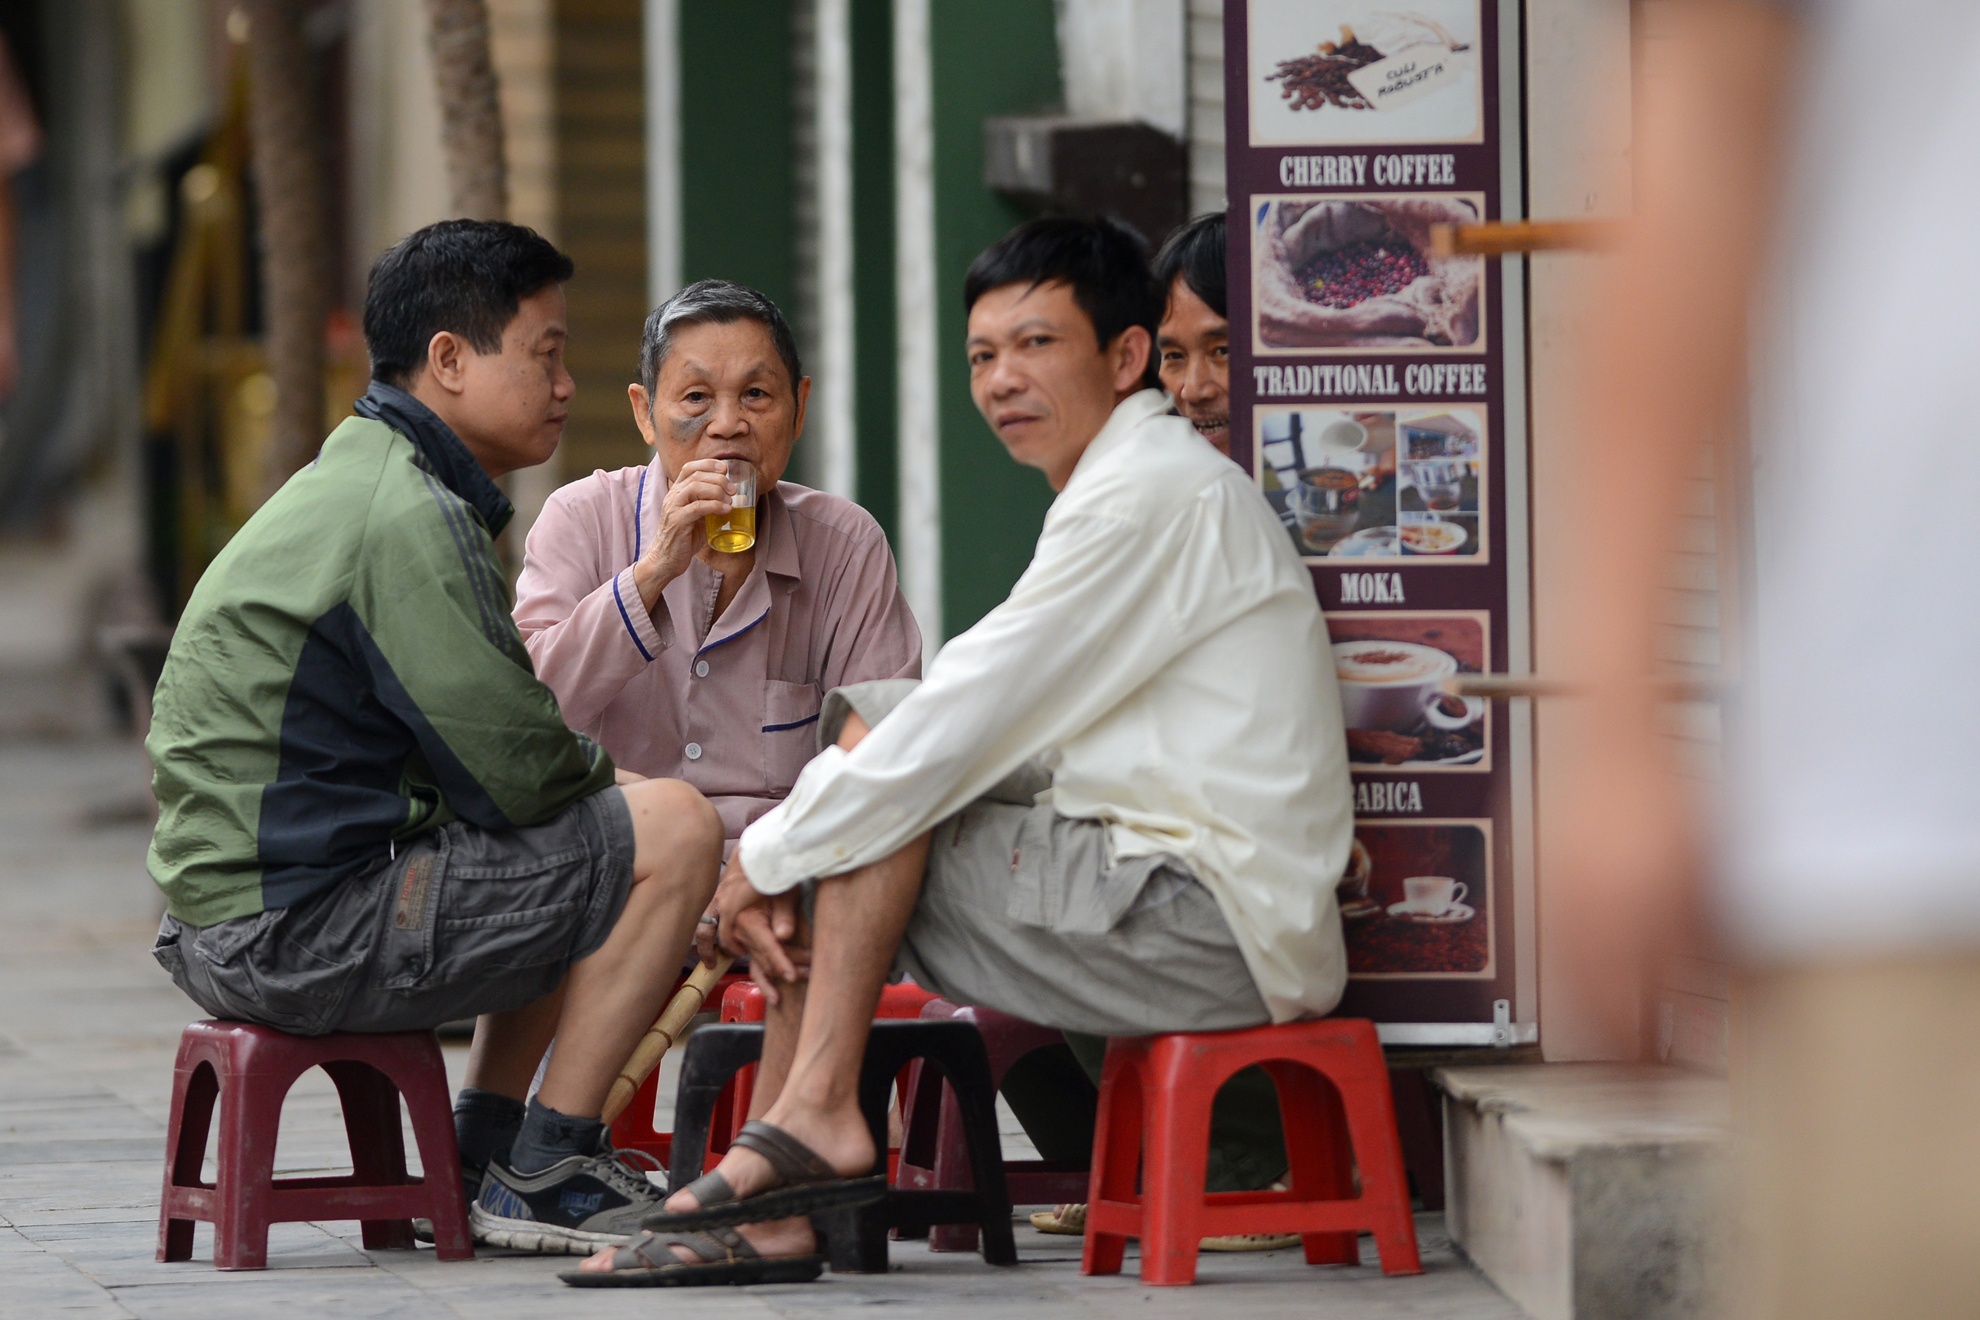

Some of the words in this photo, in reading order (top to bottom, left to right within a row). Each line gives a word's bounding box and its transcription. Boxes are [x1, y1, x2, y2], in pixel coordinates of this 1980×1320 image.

[1279, 155, 1367, 187] CHERRY
[1373, 153, 1456, 186] COFFEE
[1253, 364, 1400, 396] TRADITIONAL
[1404, 363, 1487, 395] COFFEE
[1340, 572, 1406, 604] MOKA
[1354, 781, 1423, 812] ABICA
